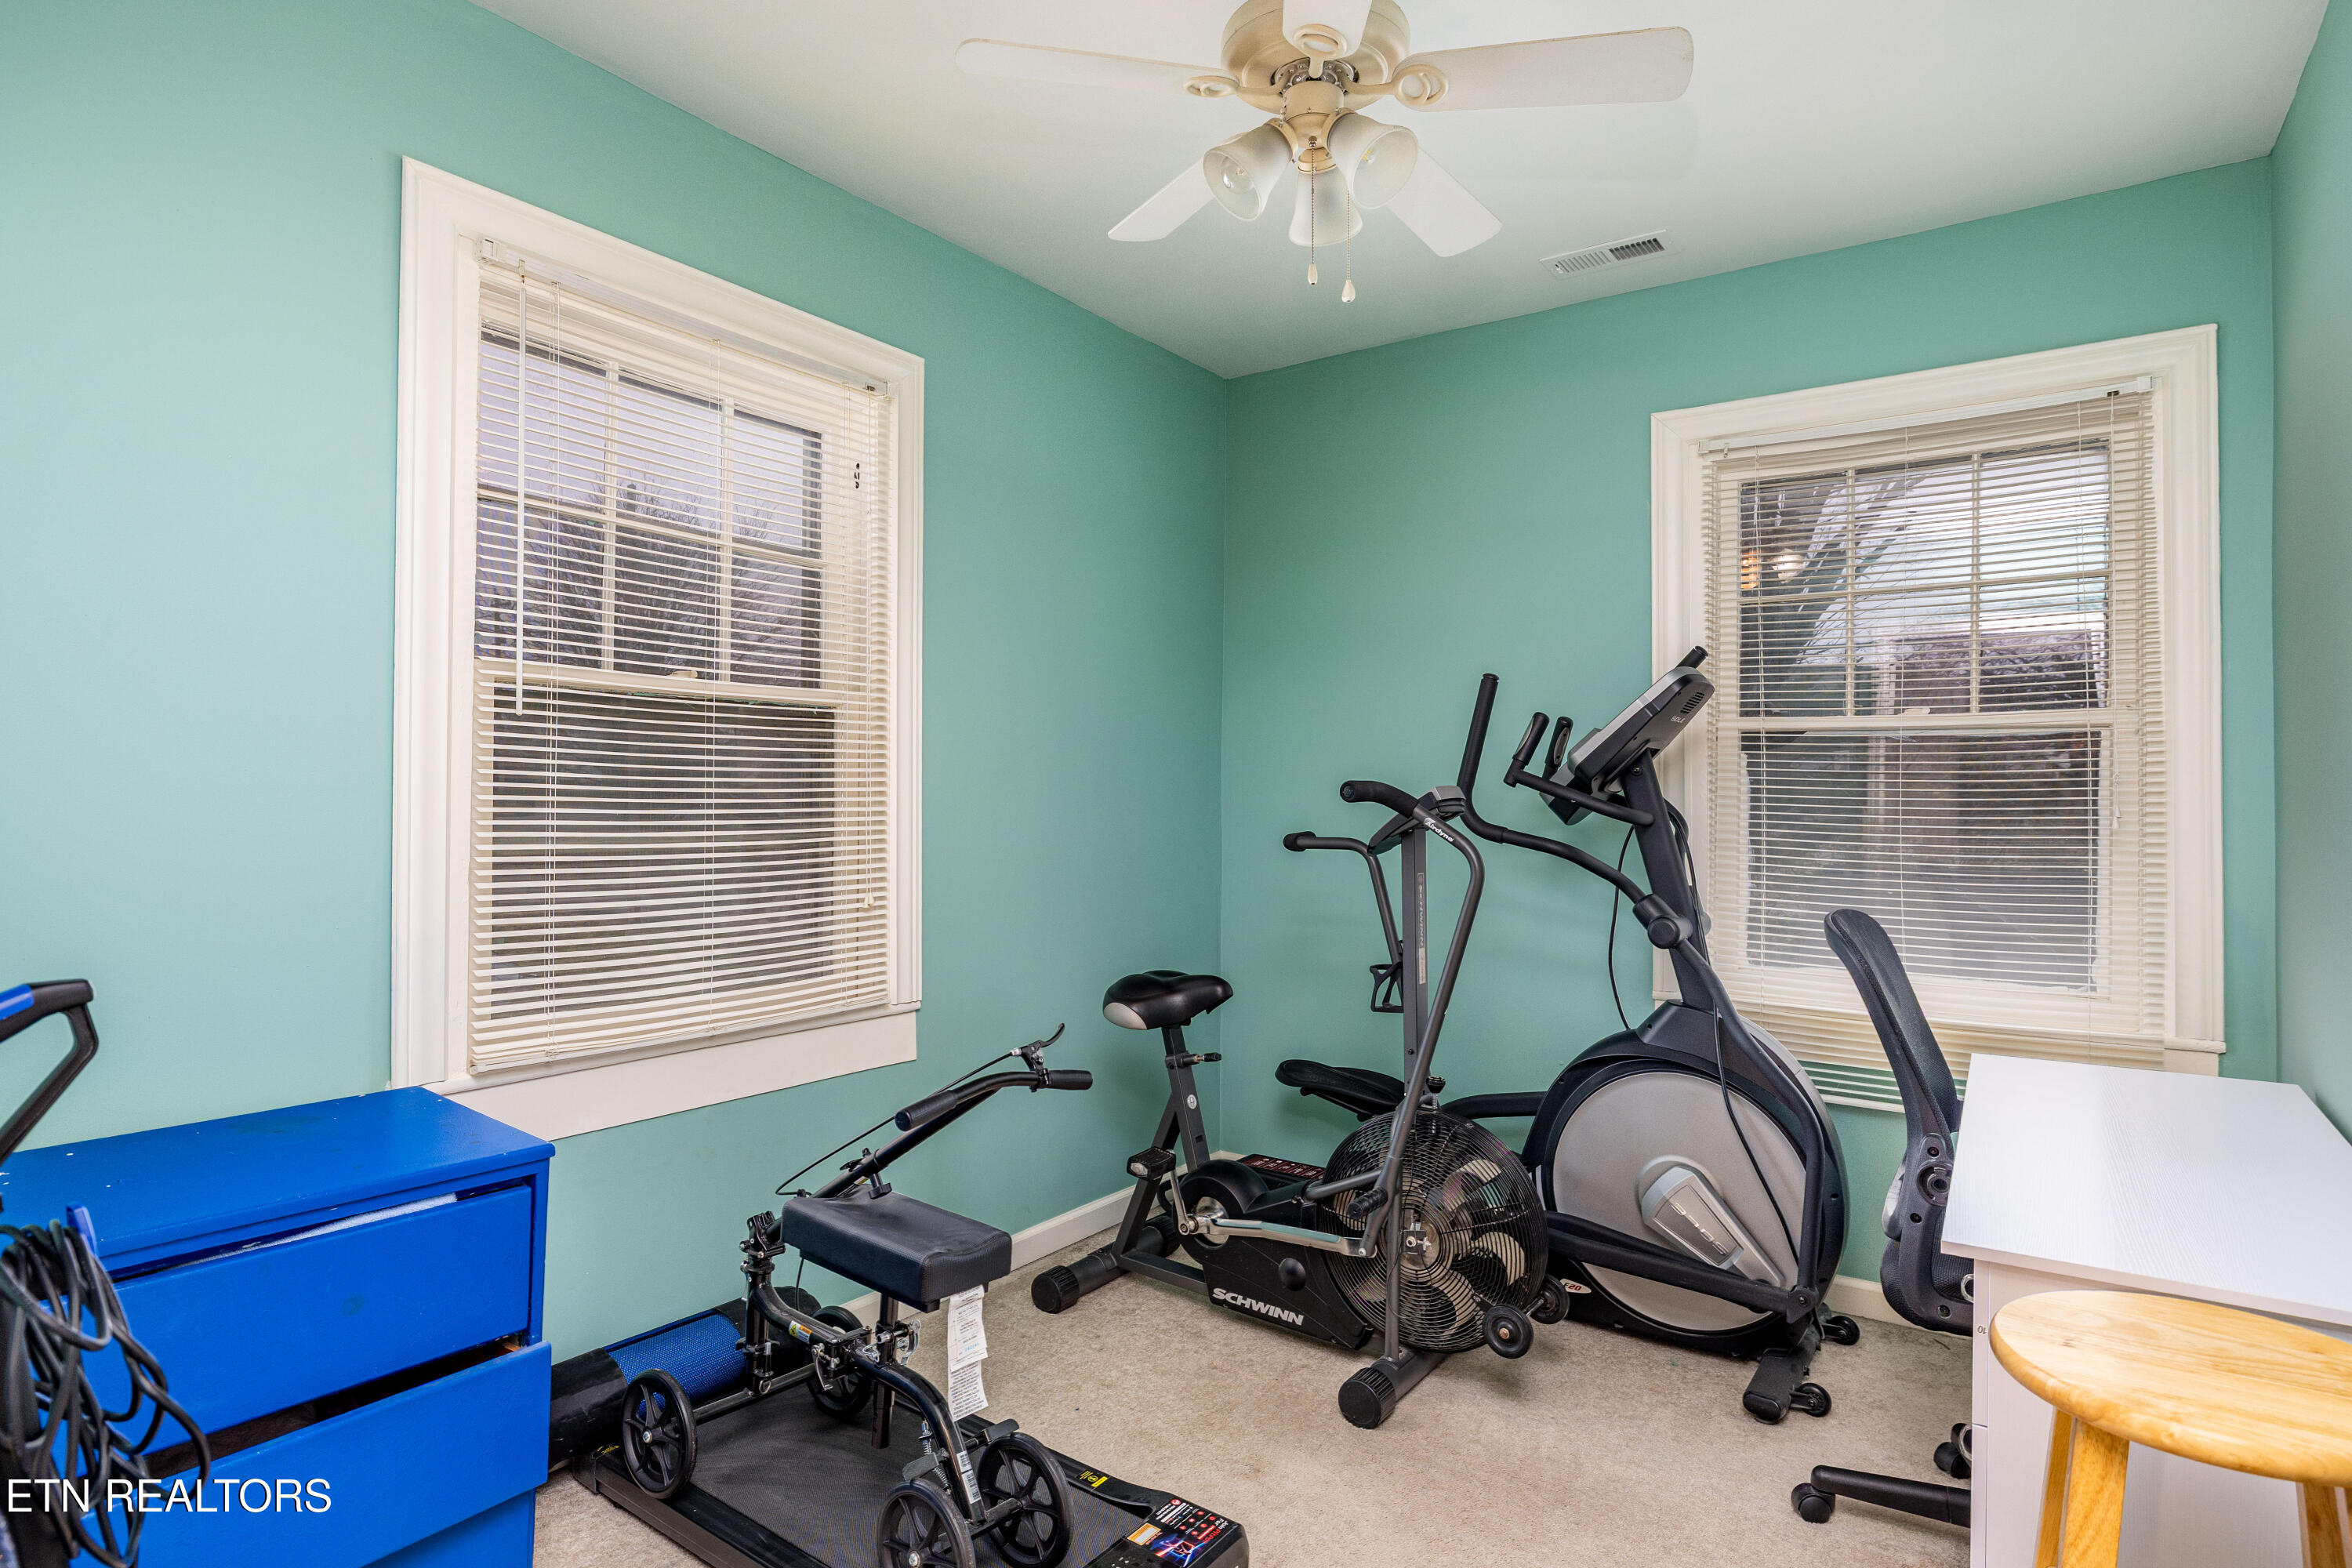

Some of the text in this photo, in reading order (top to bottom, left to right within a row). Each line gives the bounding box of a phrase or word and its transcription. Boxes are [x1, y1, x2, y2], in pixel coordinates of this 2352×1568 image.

[1425, 821, 1454, 842] Airdyne
[1671, 1202, 1727, 1256] SOLE
[1564, 1282, 1582, 1291] E20
[1212, 1287, 1305, 1326] SCHWINN
